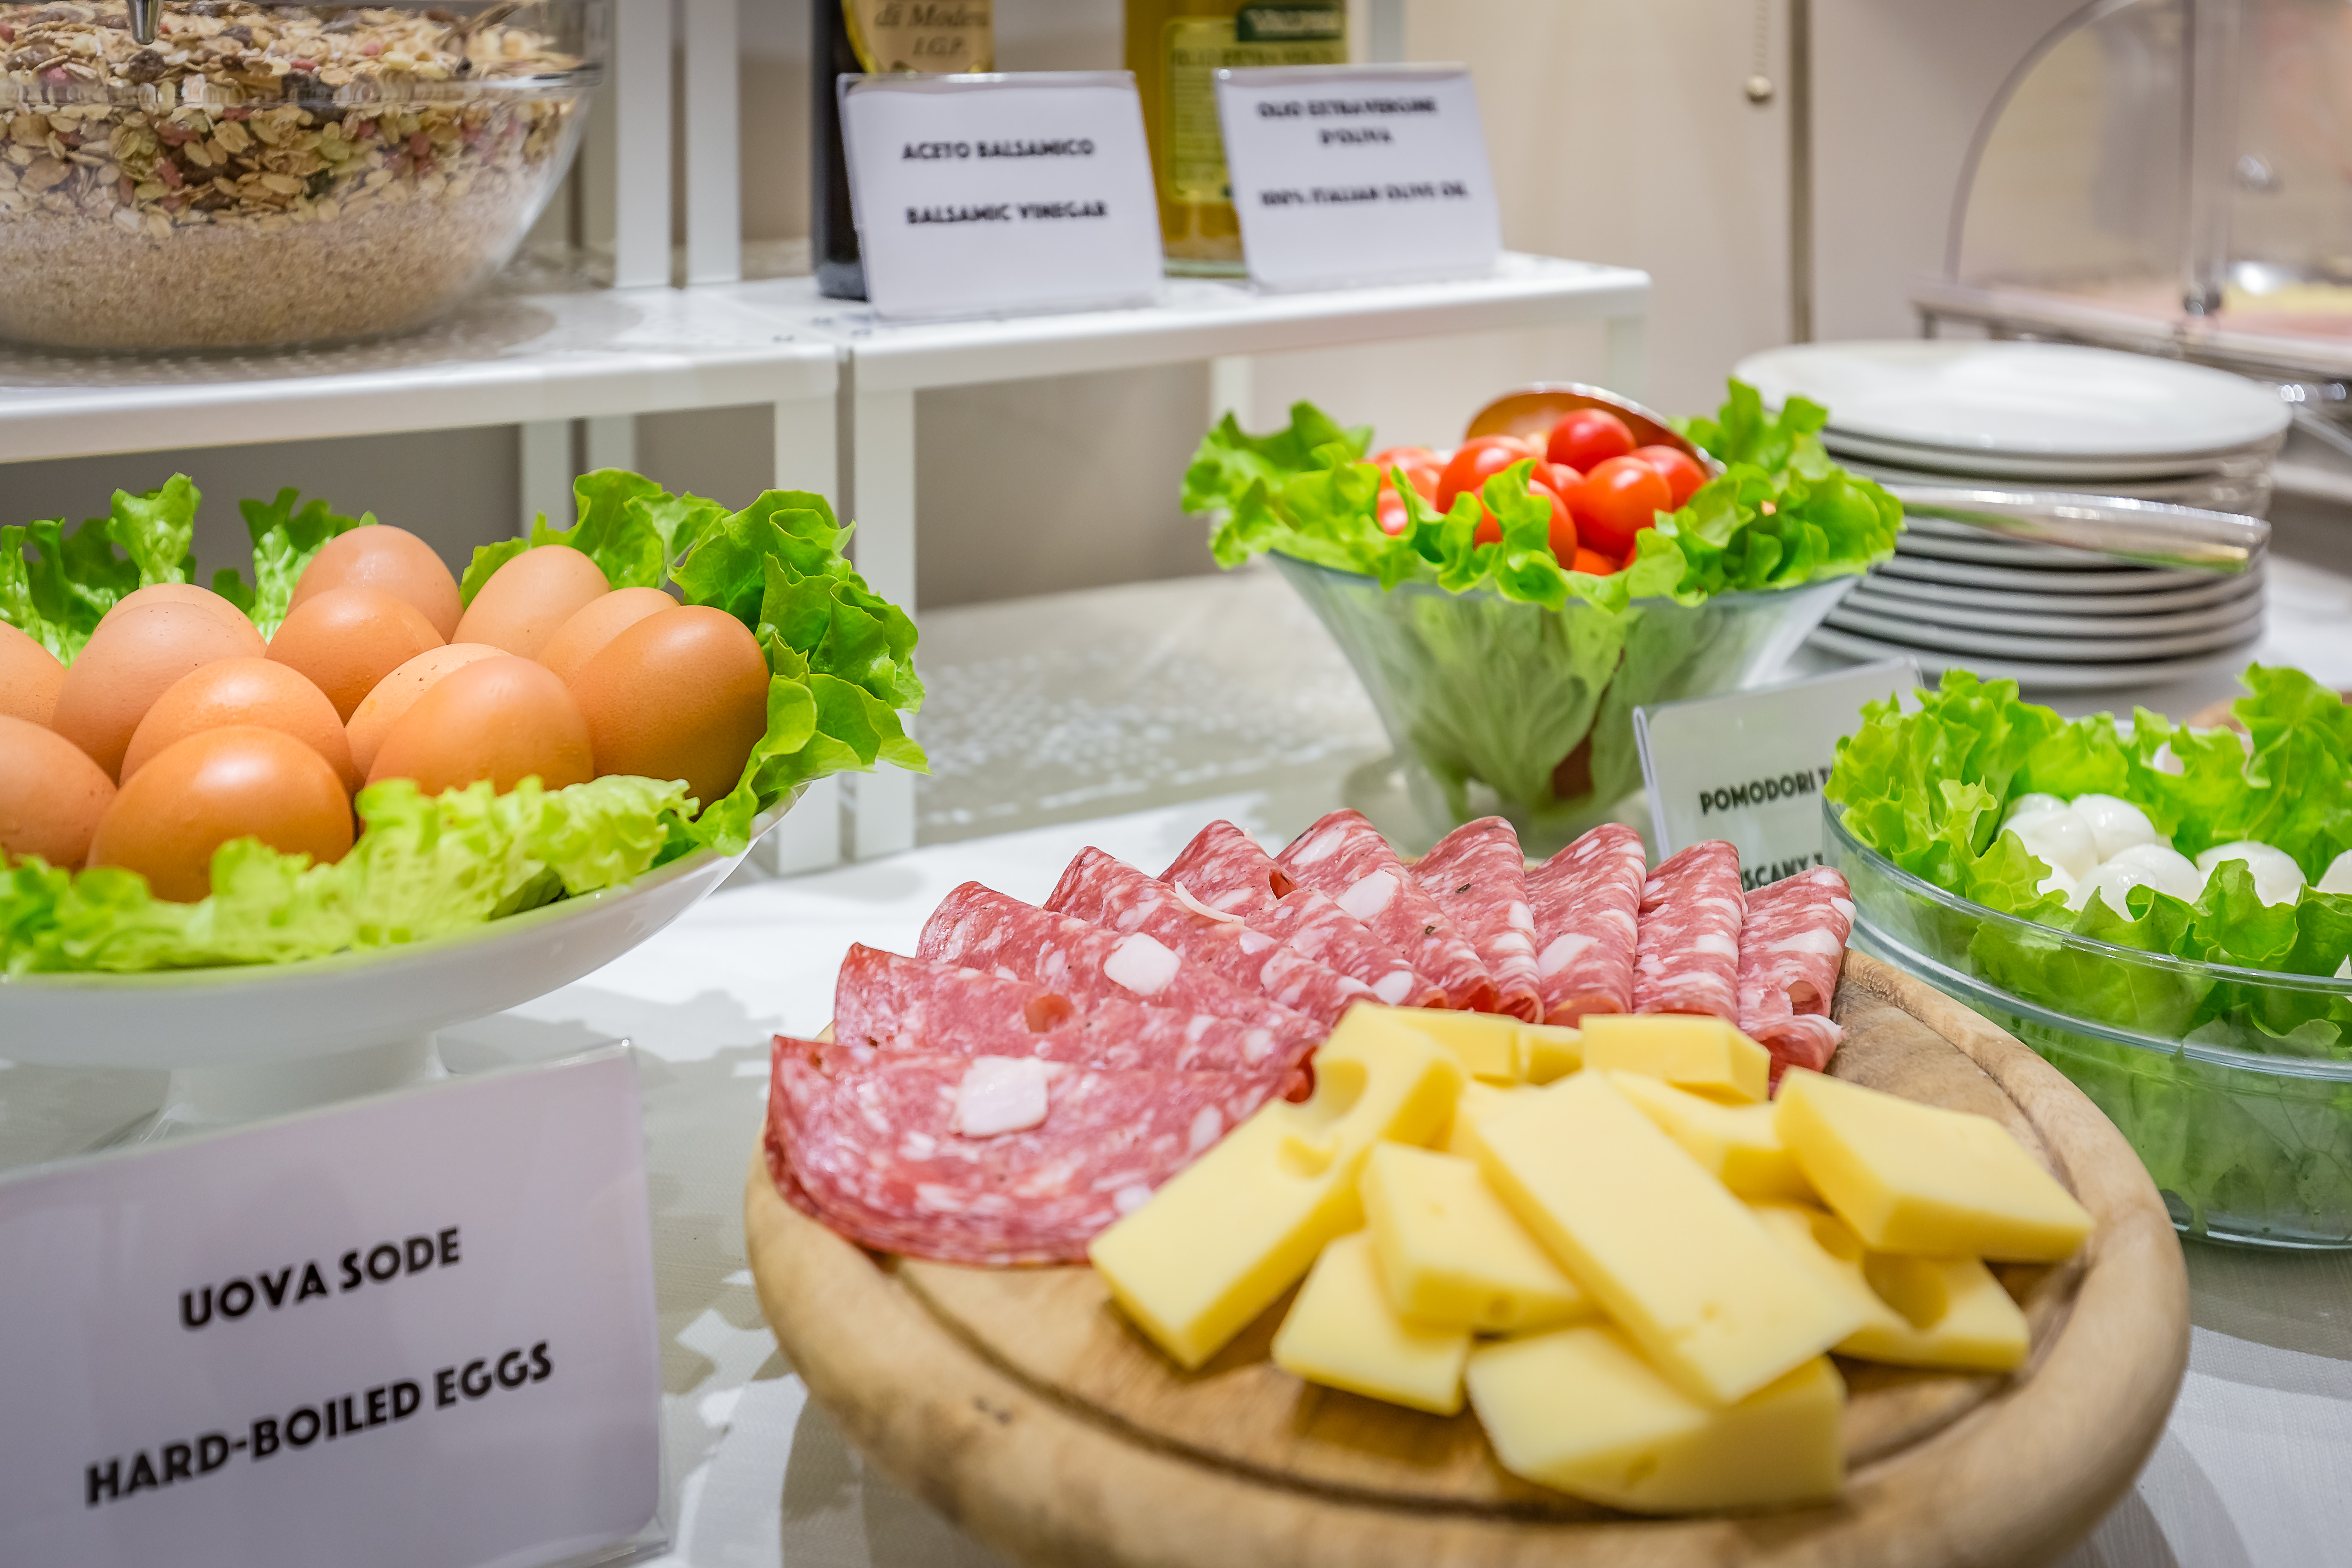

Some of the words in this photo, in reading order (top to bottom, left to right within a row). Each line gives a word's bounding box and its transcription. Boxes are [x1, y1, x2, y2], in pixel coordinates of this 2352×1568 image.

[901, 141, 972, 160] ACETO
[975, 138, 1095, 159] BALSAMICO
[905, 203, 1011, 225] BALSAMIC
[1017, 200, 1108, 220] VINEGAR
[1698, 770, 1817, 816] POMODORI
[180, 1262, 329, 1331] UOVA
[340, 1227, 460, 1293] SODE
[85, 1381, 422, 1507] HARD-BOILED
[435, 1341, 553, 1409] EGGS
